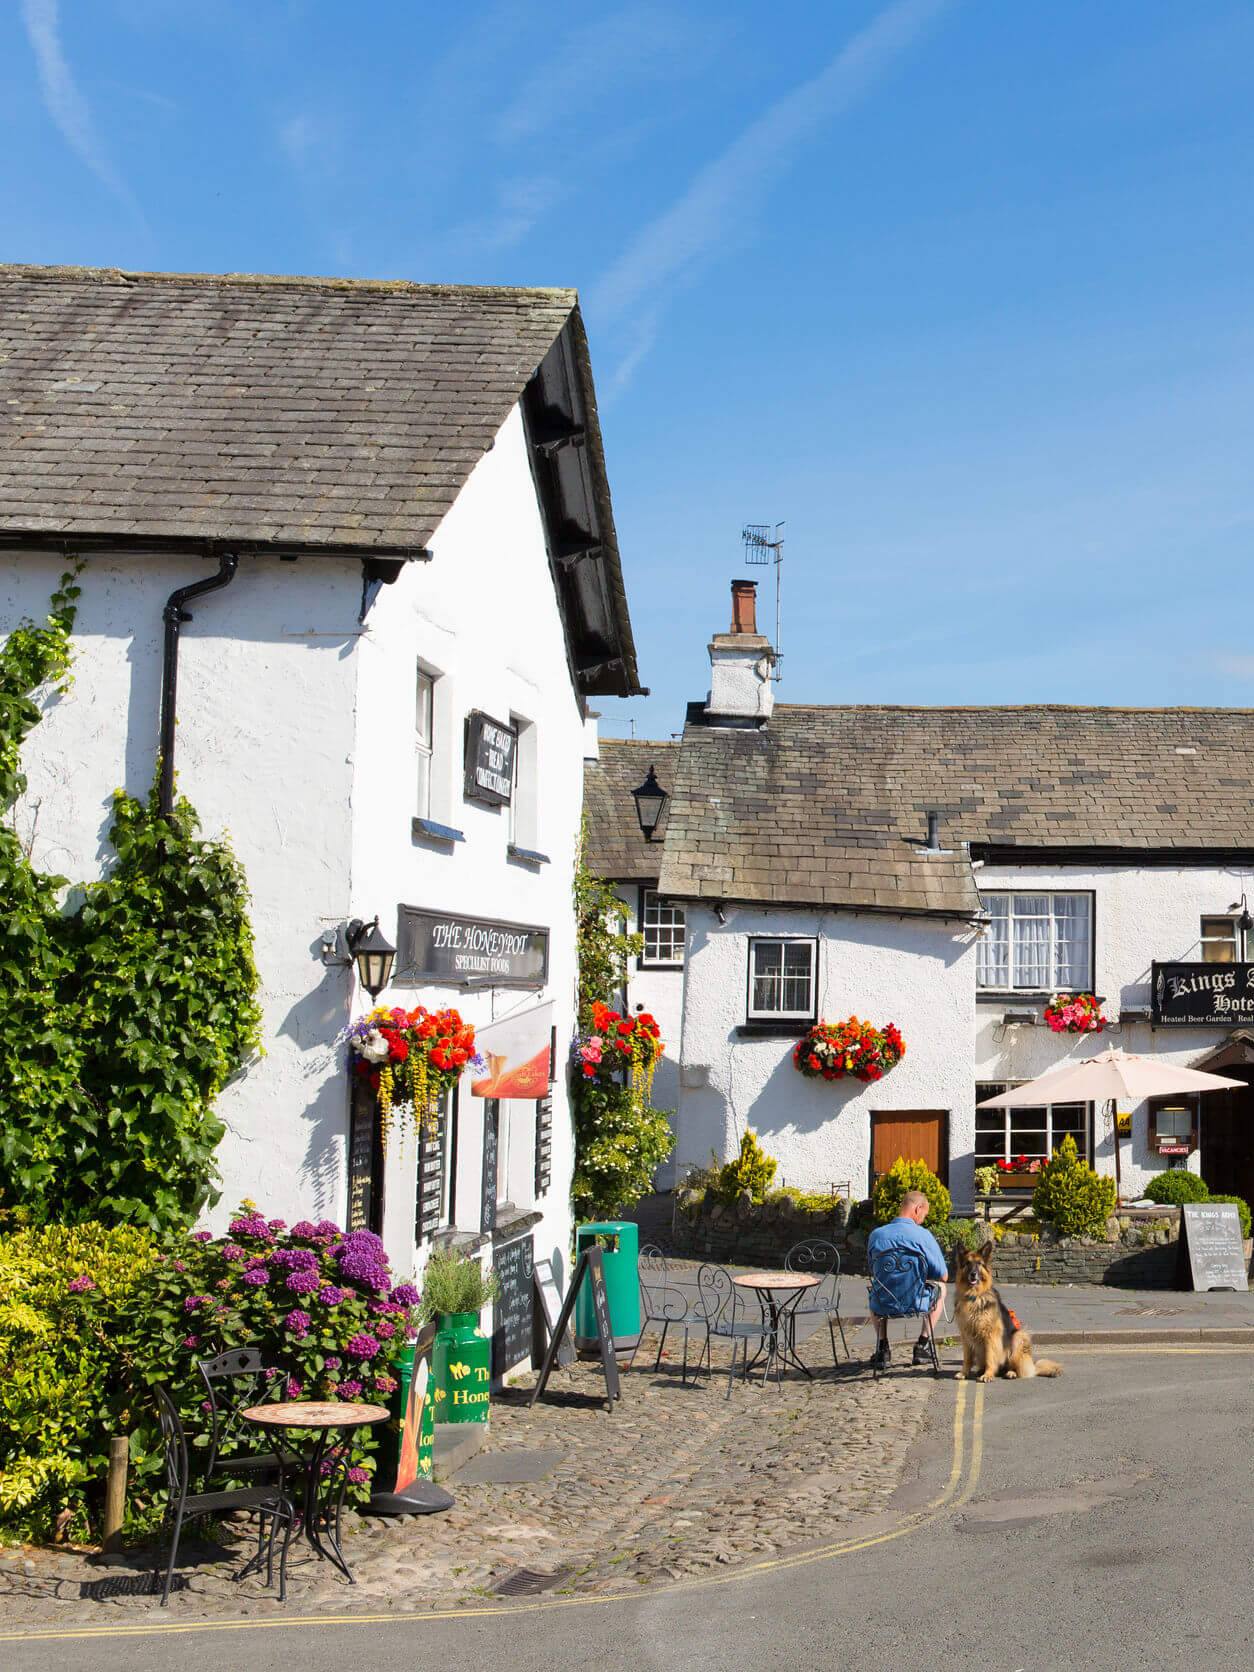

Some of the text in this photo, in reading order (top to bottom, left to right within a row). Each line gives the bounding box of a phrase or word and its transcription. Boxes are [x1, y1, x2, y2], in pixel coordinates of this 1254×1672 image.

[433, 921, 528, 957] THE HONEYPOT
[455, 954, 490, 970] SPECIALIST
[1167, 970, 1236, 999] Kings
[1161, 1014, 1186, 1023] Heated
[1187, 1014, 1205, 1023] Beer
[1205, 1014, 1232, 1023] Garden
[1238, 1014, 1254, 1023] Real
[1161, 1146, 1188, 1154] VACANCIES
